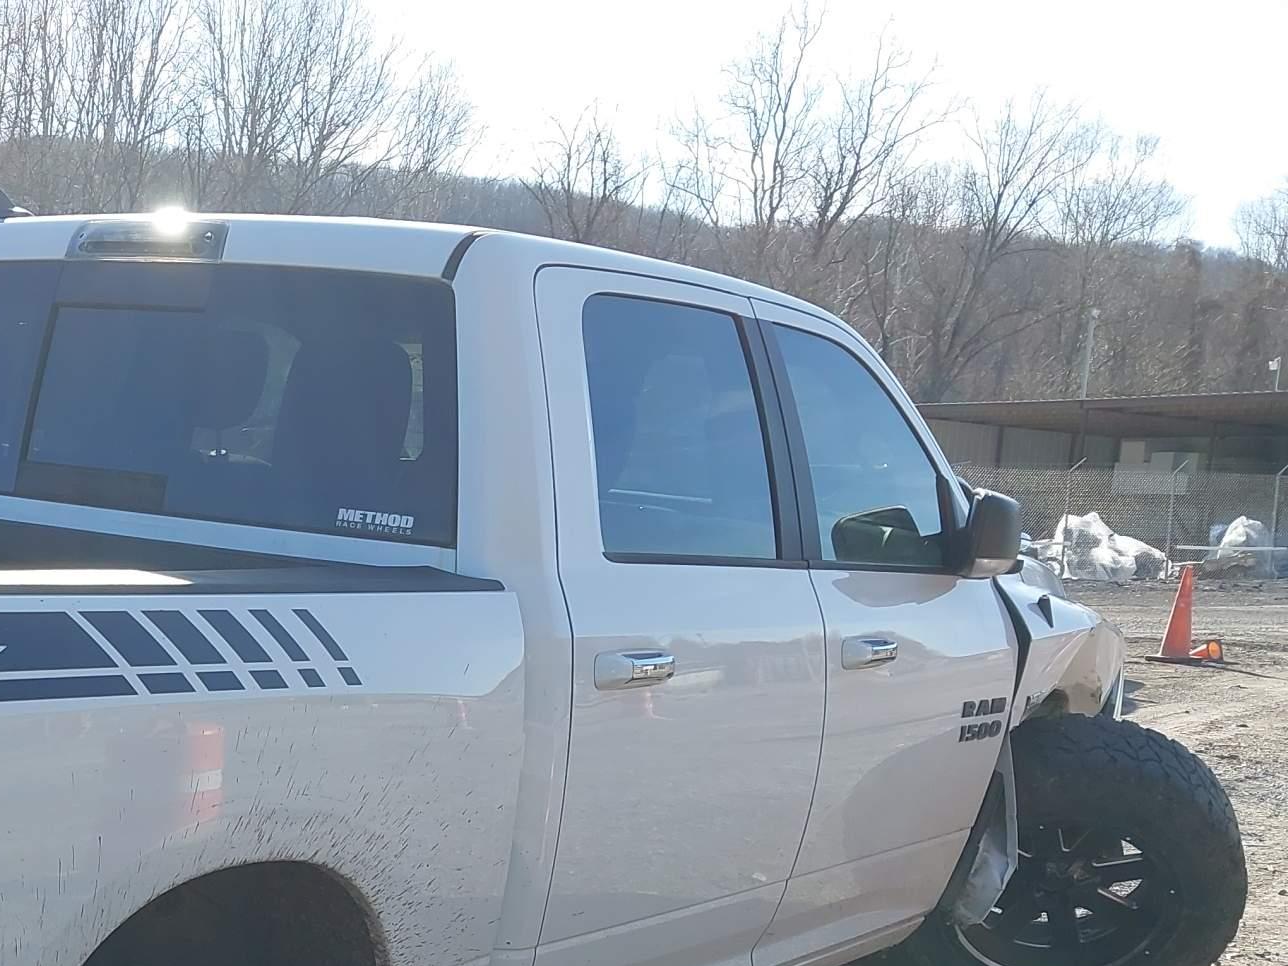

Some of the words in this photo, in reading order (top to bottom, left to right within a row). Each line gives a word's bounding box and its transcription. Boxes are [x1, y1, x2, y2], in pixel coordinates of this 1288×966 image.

[335, 520, 362, 529] RACE
[367, 523, 412, 535] WHEELS
[337, 508, 414, 528] METHOD
[958, 719, 1003, 743] 1500
